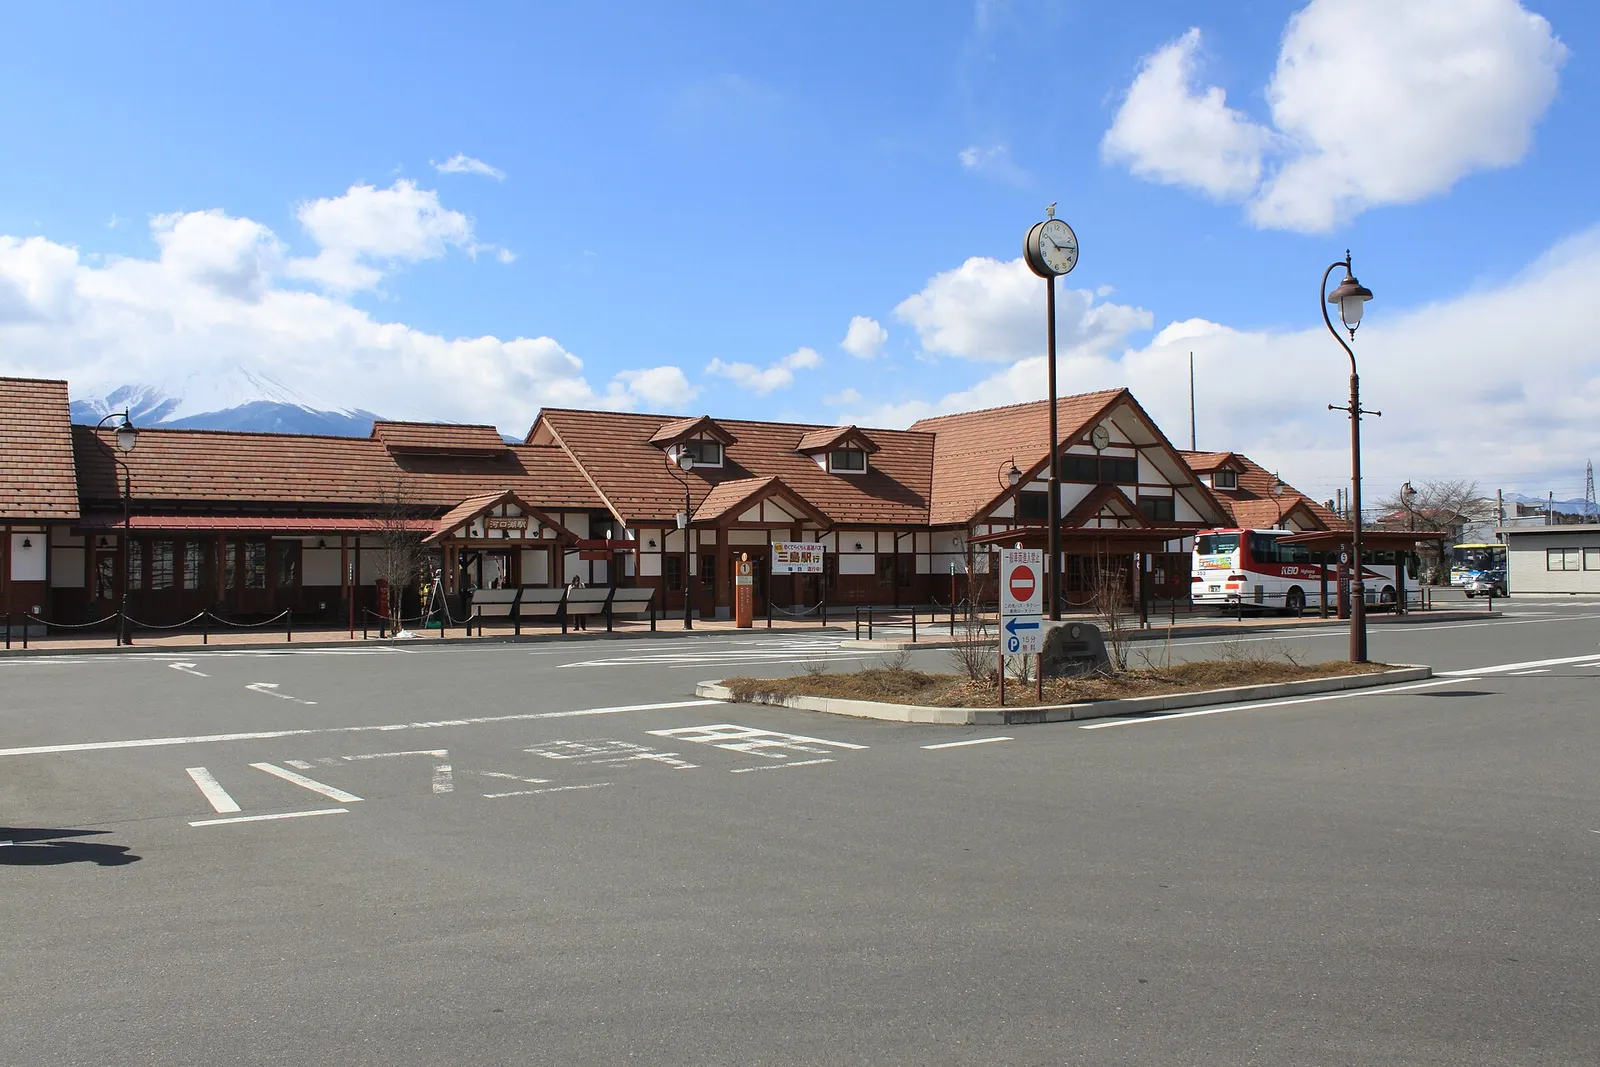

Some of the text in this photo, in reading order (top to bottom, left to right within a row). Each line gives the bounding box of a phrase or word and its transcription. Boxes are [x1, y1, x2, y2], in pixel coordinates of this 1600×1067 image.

[489, 520, 527, 529] 河口湖駅
[777, 551, 820, 563] 三島駅行
[1004, 552, 1040, 564] 一般車両進入禁止
[1281, 566, 1299, 575] KEIO
